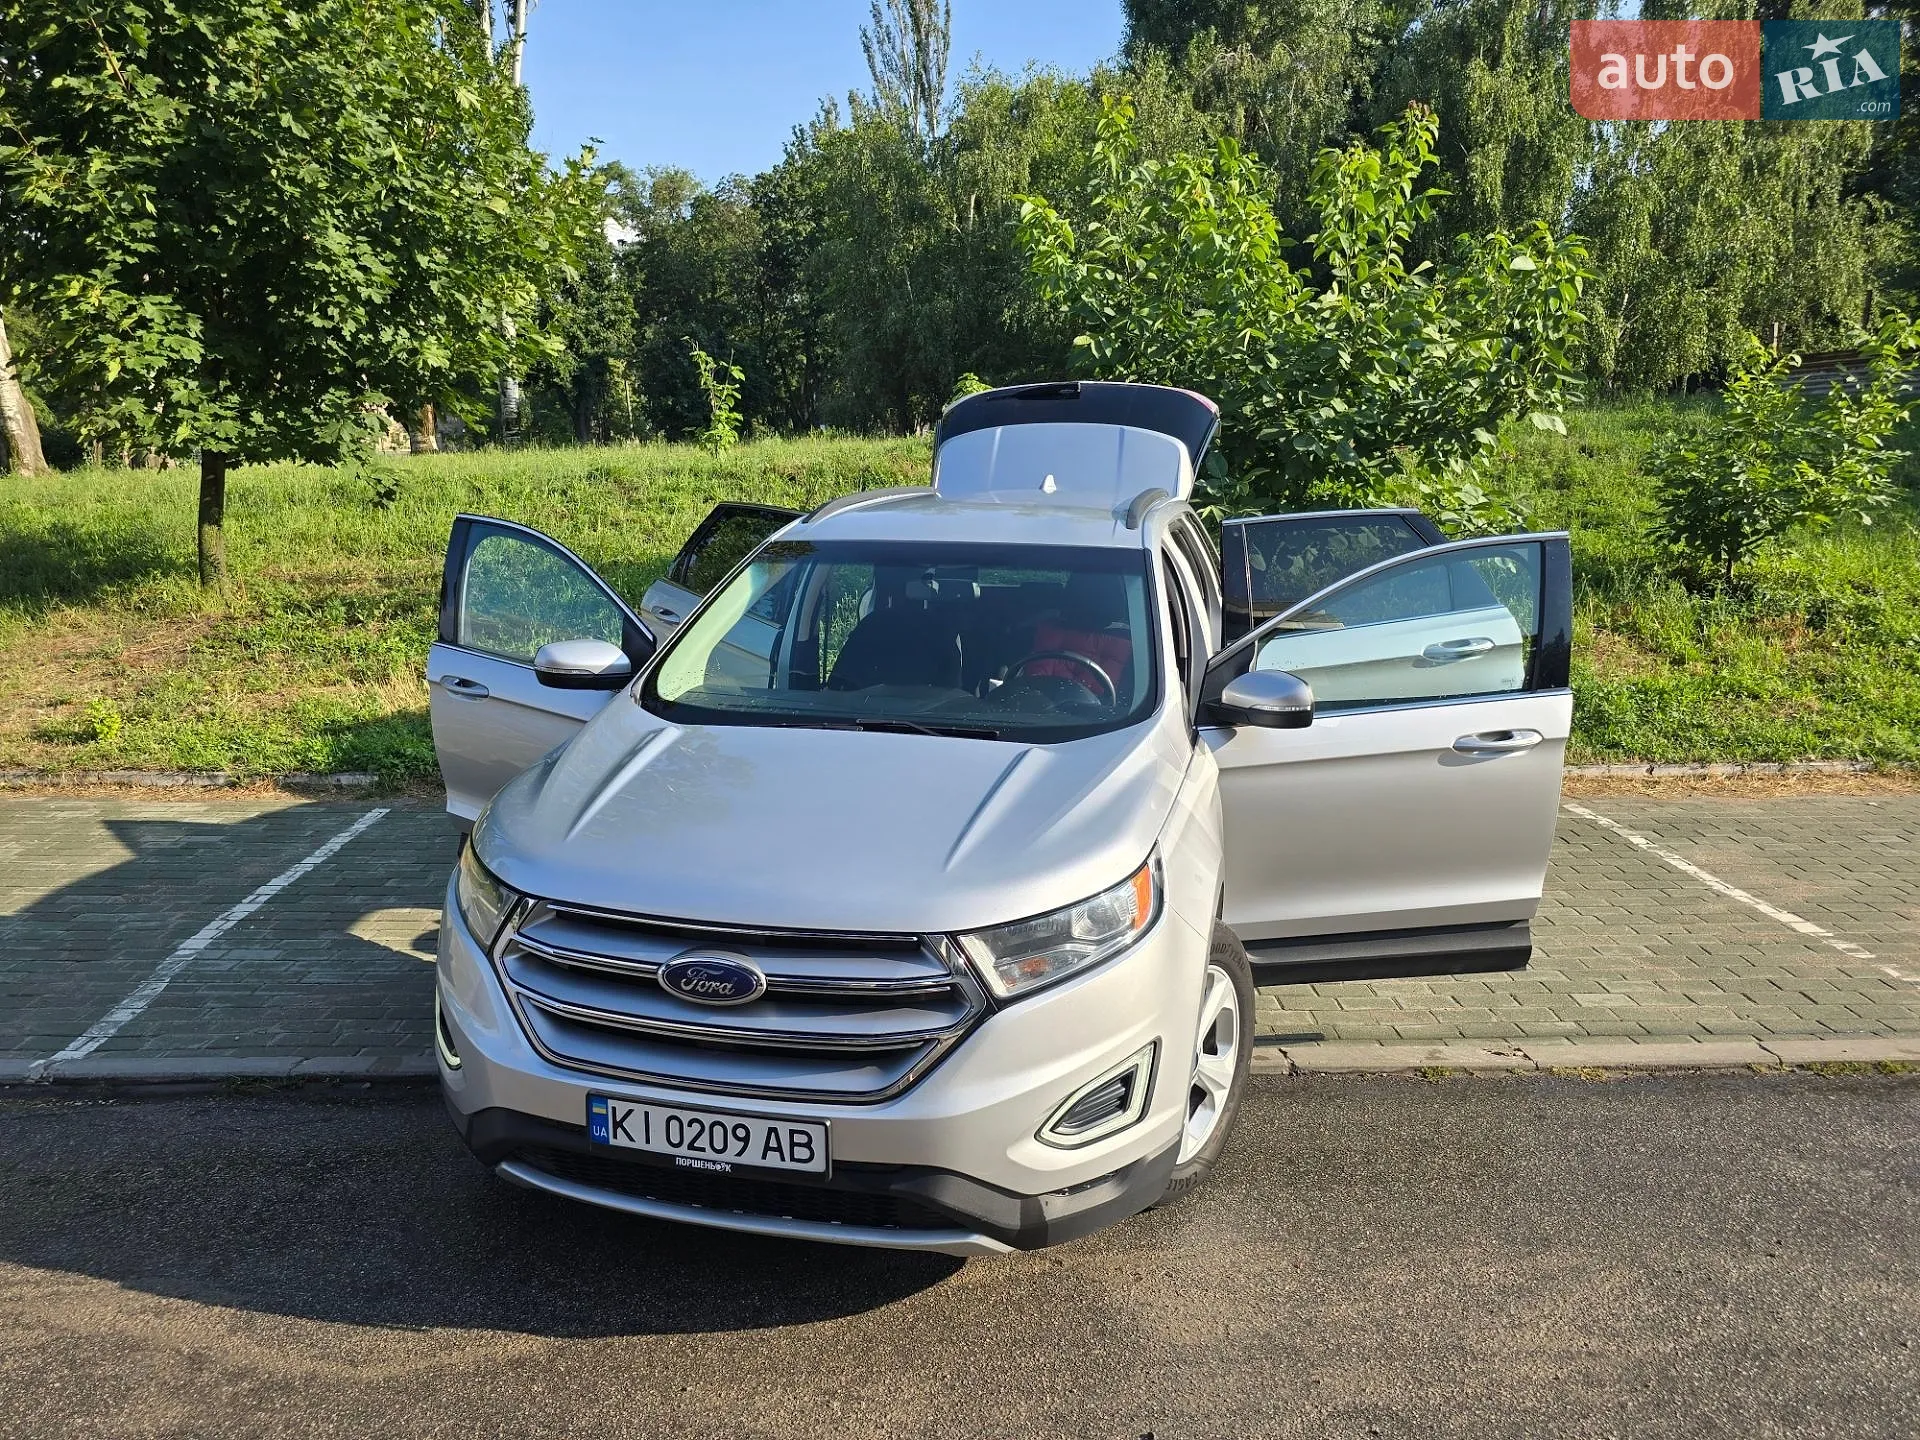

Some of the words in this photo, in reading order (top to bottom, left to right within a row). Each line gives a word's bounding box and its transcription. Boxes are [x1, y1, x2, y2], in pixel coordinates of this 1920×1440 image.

[680, 966, 735, 995] Ford
[593, 1125, 608, 1138] UA
[611, 1105, 651, 1145] KI
[665, 1115, 751, 1157] 0209
[761, 1126, 815, 1164] AB
